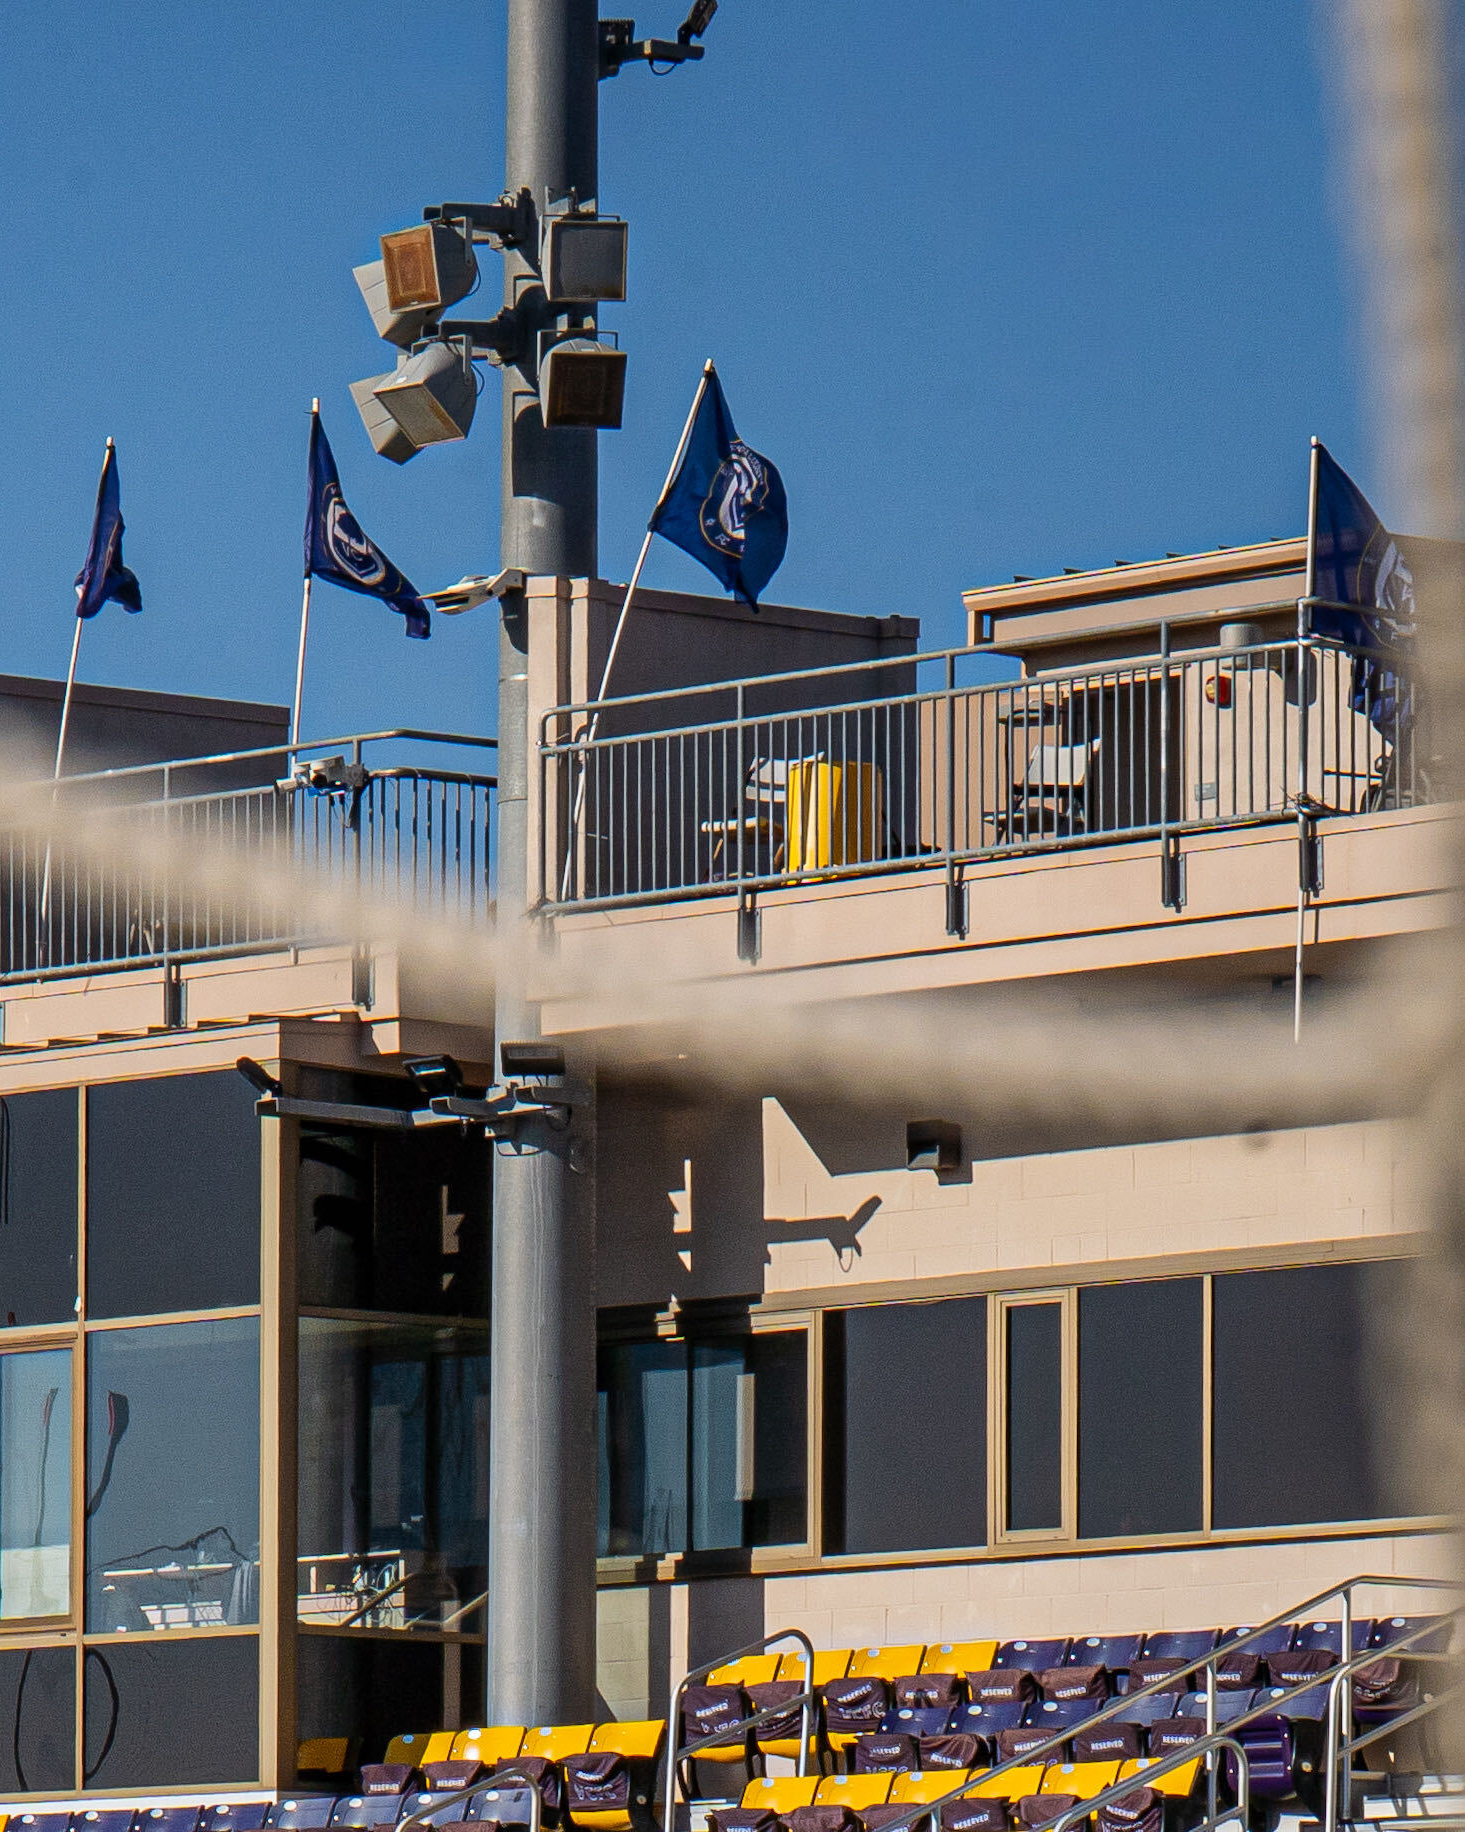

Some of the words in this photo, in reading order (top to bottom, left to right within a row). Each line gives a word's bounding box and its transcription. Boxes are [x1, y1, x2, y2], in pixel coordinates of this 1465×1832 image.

[981, 1686, 1013, 1697] RESERVED
[1091, 1738, 1124, 1751] RESERVED
[953, 1812, 990, 1830] RESERVED
